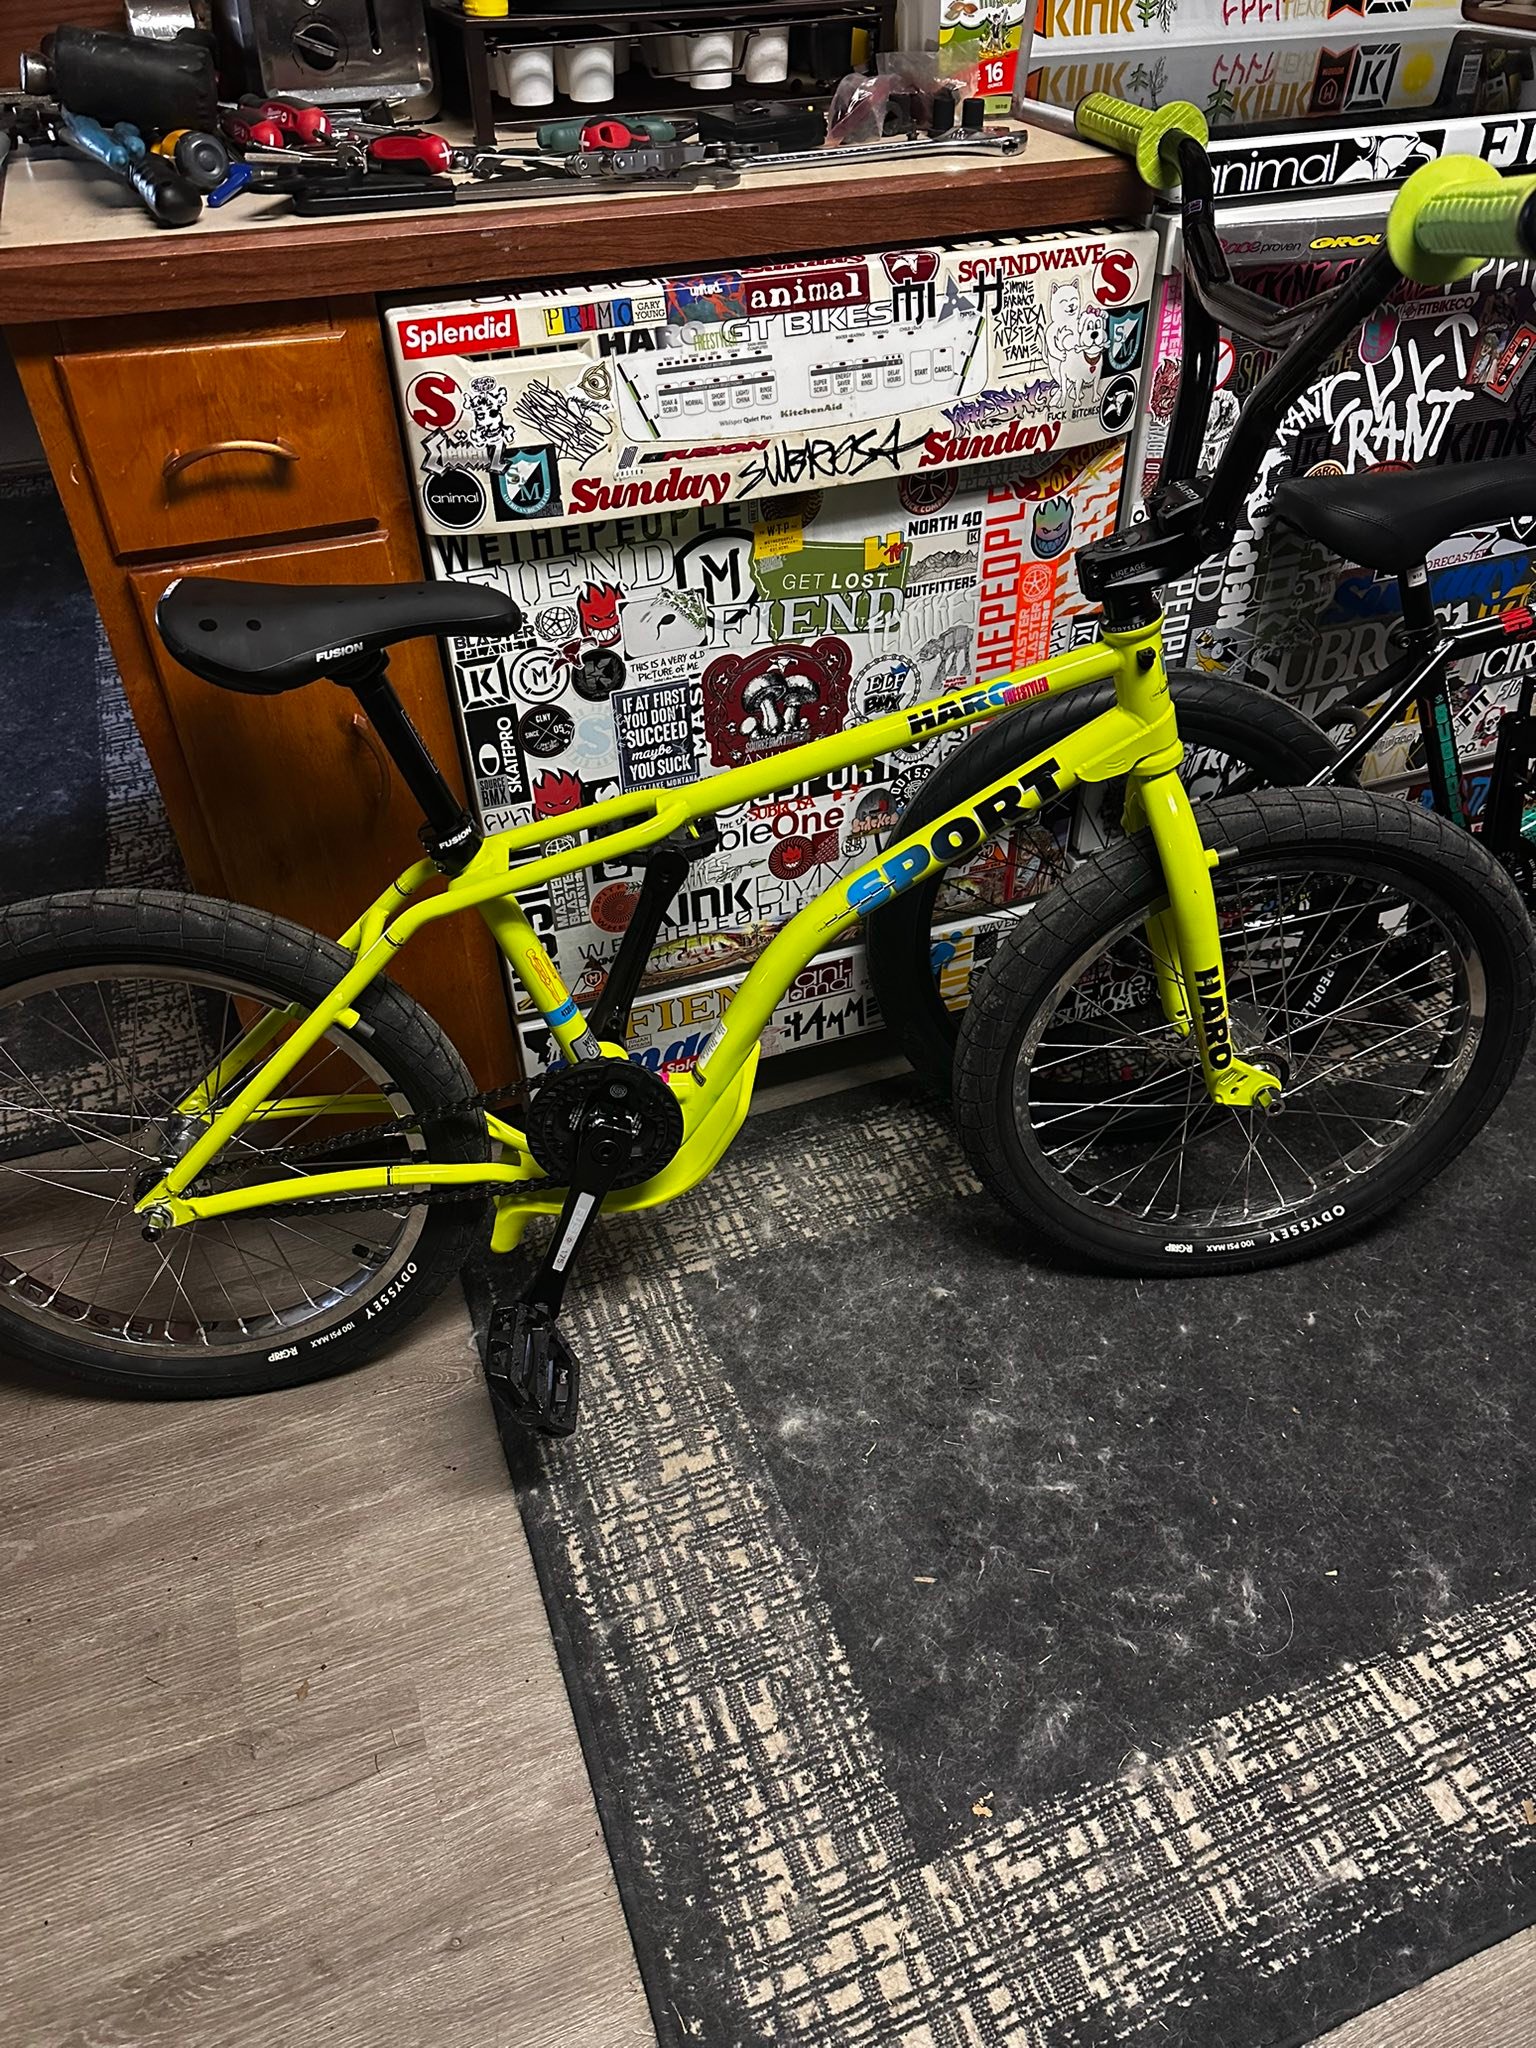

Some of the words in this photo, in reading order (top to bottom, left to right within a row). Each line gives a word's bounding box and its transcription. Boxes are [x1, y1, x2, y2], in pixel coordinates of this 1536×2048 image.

[985, 61, 1004, 83] 16
[1260, 240, 1301, 254] proven
[750, 272, 863, 309] animal
[634, 308, 666, 320] YOUNG
[636, 300, 661, 311] GARY
[547, 300, 634, 331] PRIMO
[722, 314, 776, 345] GT
[784, 299, 893, 337] BIKES
[405, 313, 512, 353] Splendid
[597, 320, 706, 358] HARO
[914, 367, 929, 377] START
[934, 364, 953, 374] CANCEL
[759, 386, 773, 394] RINSE
[813, 378, 828, 386] SUPER
[413, 376, 457, 429] S
[685, 399, 704, 407] NORMAL
[711, 392, 726, 400] SHORT
[780, 403, 843, 418] KitchenAid
[1047, 411, 1067, 422] FUCK
[1071, 405, 1101, 419] BITCHES
[743, 416, 759, 425] Quiet
[918, 419, 1062, 470] Sunday
[430, 491, 480, 505] animal
[567, 466, 731, 516] Sunday
[1173, 480, 1201, 501] HARO
[908, 514, 959, 537] NORTH
[961, 510, 983, 527] 40
[1110, 561, 1148, 580] LINEAGE
[782, 573, 825, 590] GET
[904, 574, 977, 600] OUTFITTERS
[1110, 620, 1147, 633] ODYSSEY
[316, 641, 364, 663] FUSION
[631, 659, 649, 673] THIS
[651, 658, 659, 668] IS
[667, 654, 688, 666] VERY
[687, 661, 700, 671] ME
[622, 697, 633, 714] IF
[635, 694, 651, 711] AT
[653, 687, 686, 708] FIRST
[906, 681, 1015, 736] HARO
[1459, 688, 1491, 727] FIT
[535, 713, 551, 724] CLNY
[624, 711, 648, 730] YOU
[650, 703, 687, 724] DON'T
[626, 720, 689, 749] SUCCEED
[497, 716, 523, 794] SKATEPRO
[631, 743, 673, 762] maybe
[629, 763, 655, 782] YOU
[657, 753, 692, 775] SUCK
[481, 787, 509, 807] BMX
[746, 795, 817, 822] SUBROSA
[438, 825, 473, 850] FUSION
[845, 757, 1062, 918] SPORT
[1194, 964, 1233, 1071] HARO
[1268, 1204, 1346, 1244] ODYSSEY
[1206, 1243, 1227, 1253] MAX
[1227, 1242, 1240, 1251] PSI
[1240, 1239, 1256, 1248] 100
[364, 1261, 418, 1321] ODYSSEY
[329, 1328, 342, 1341] PSI
[341, 1321, 356, 1333] 100
[310, 1333, 330, 1349] MAX
